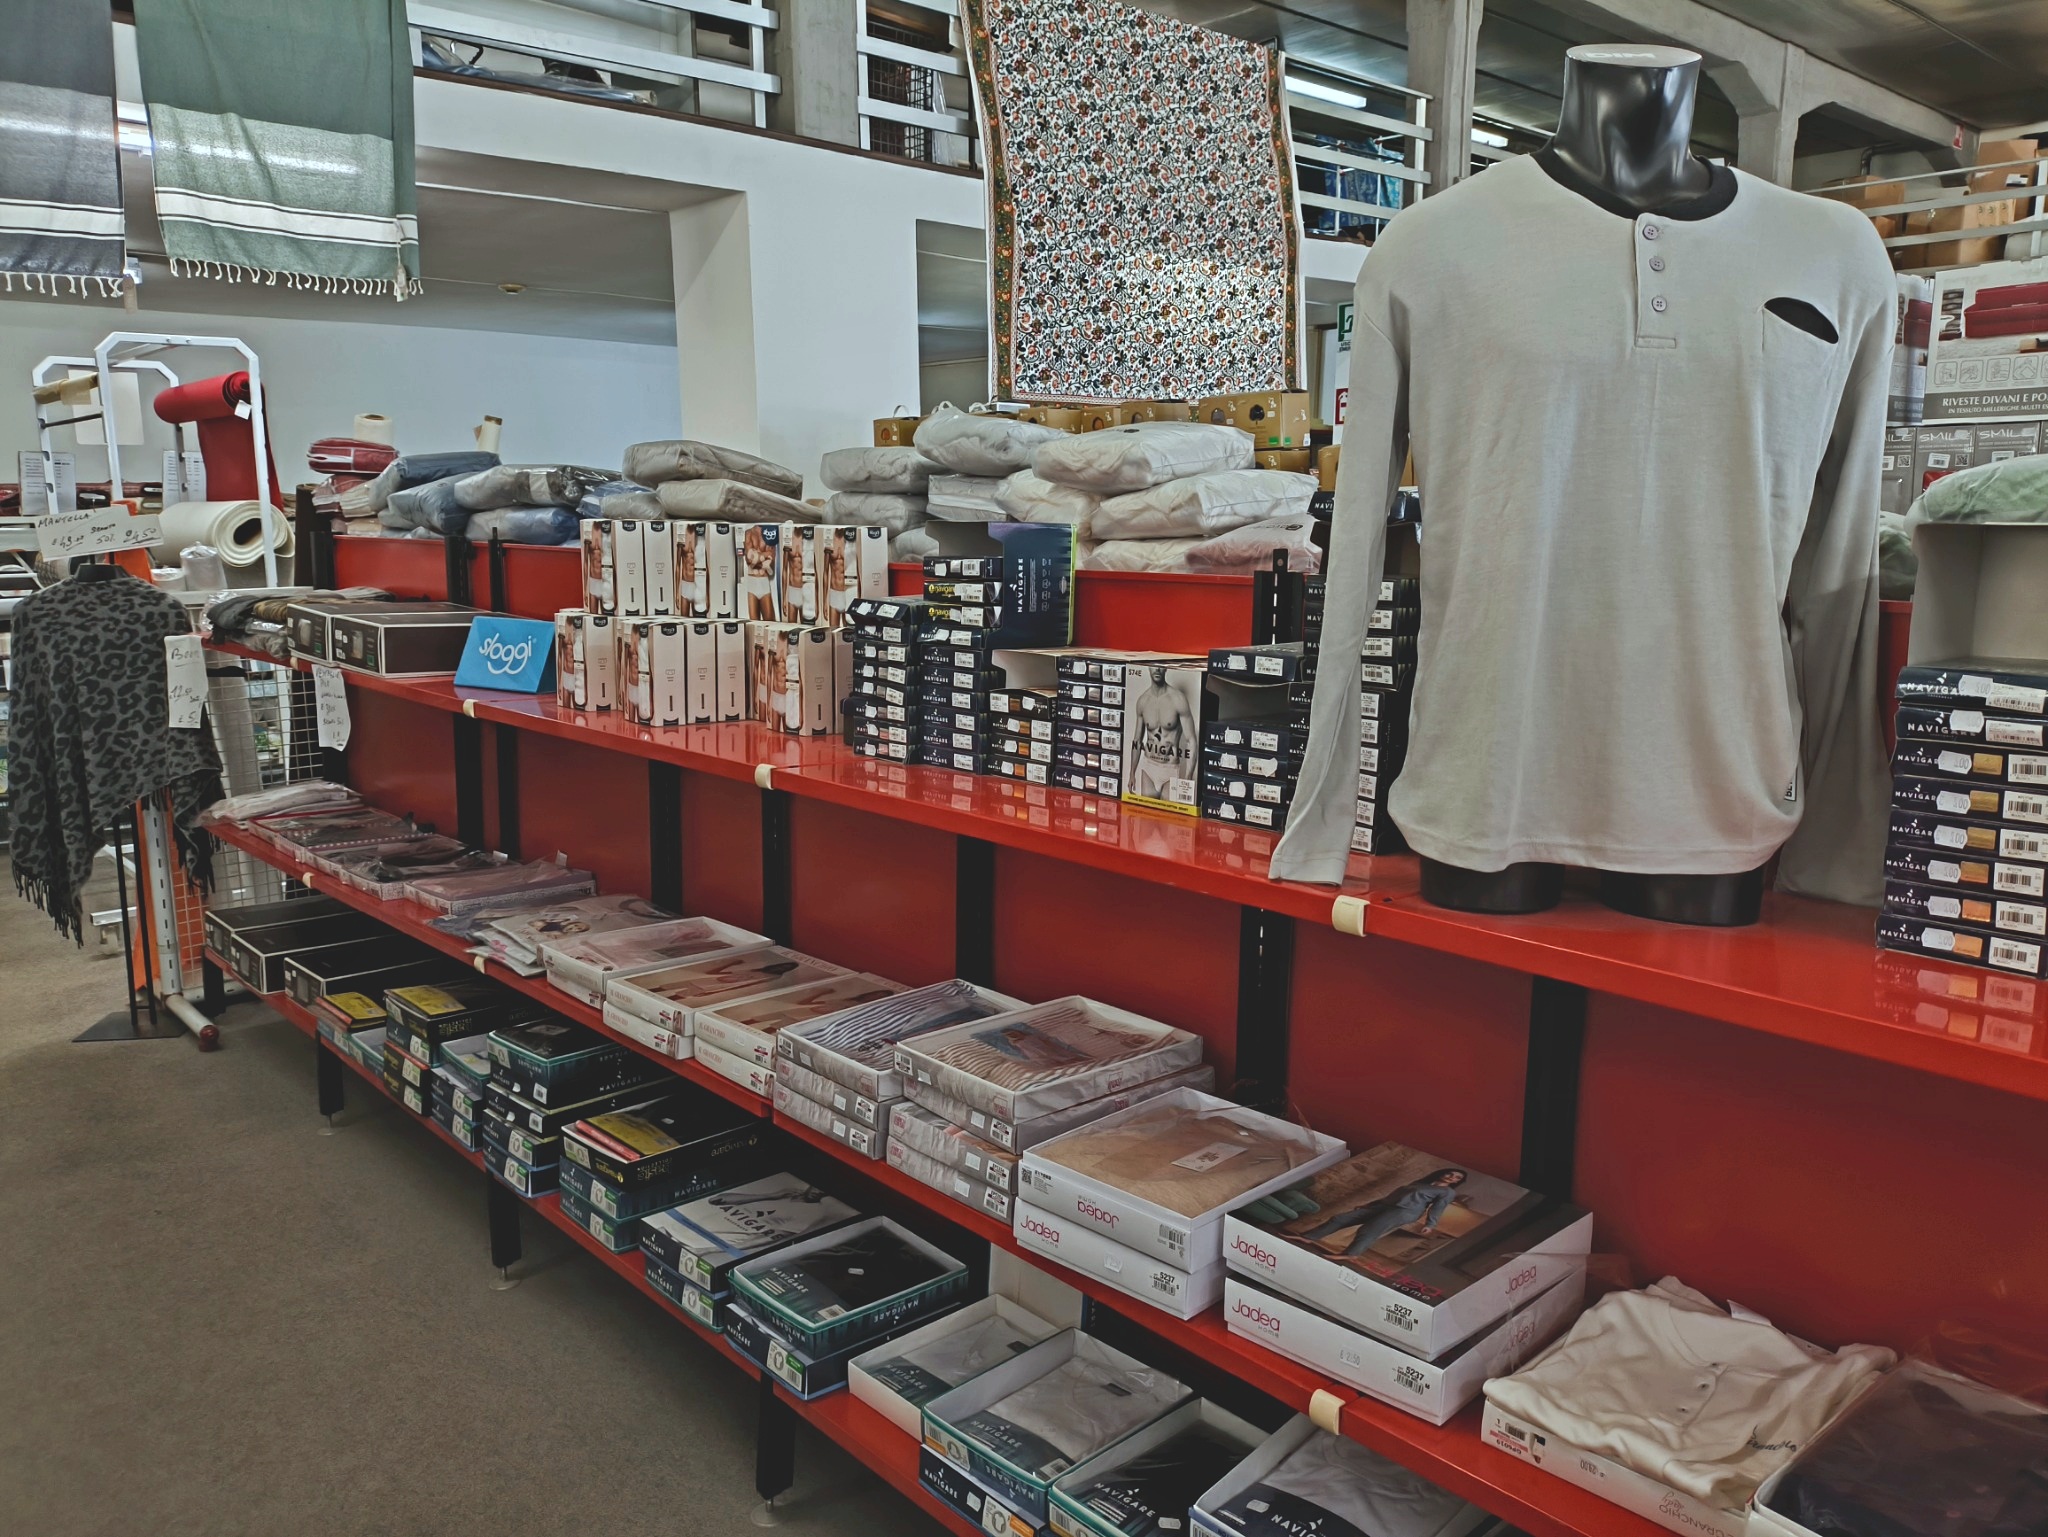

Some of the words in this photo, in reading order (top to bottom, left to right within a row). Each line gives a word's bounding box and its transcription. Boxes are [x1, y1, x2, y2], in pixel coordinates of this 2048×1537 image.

[1942, 396, 1980, 407] RIVESTE
[1982, 394, 2020, 405] DIVANI
[2022, 393, 2029, 402] E
[2031, 393, 2048, 402] PO
[479, 633, 532, 675] sloggi
[1906, 682, 1961, 697] NAVIGA
[1131, 740, 1191, 759] NAVIGARE
[1897, 755, 1938, 765] NAVIGAR
[1895, 791, 1937, 801] NAVIGAR
[1892, 825, 1933, 837] NAVIGAR
[1886, 859, 1927, 871] NAVIGAR
[1887, 894, 1928, 906] NAVIGAR
[1880, 929, 1920, 942] NAVIGAR
[713, 1198, 788, 1241] NAVIGARE
[1077, 1200, 1120, 1228] Jadea
[1020, 1215, 1060, 1243] Jadea
[1231, 1234, 1276, 1268] Jadea
[771, 1267, 808, 1294] NAVIGARE
[1159, 1271, 1175, 1284] 5237
[1505, 1264, 1537, 1294] Jadea
[1232, 1298, 1281, 1331] Jadea
[1394, 1303, 1412, 1317] 5237
[1405, 1366, 1425, 1381] 5237
[970, 1419, 1023, 1448] NAVIGARE
[924, 1468, 958, 1499] NAVIGARE
[1094, 1482, 1156, 1518] NAVIGARE
